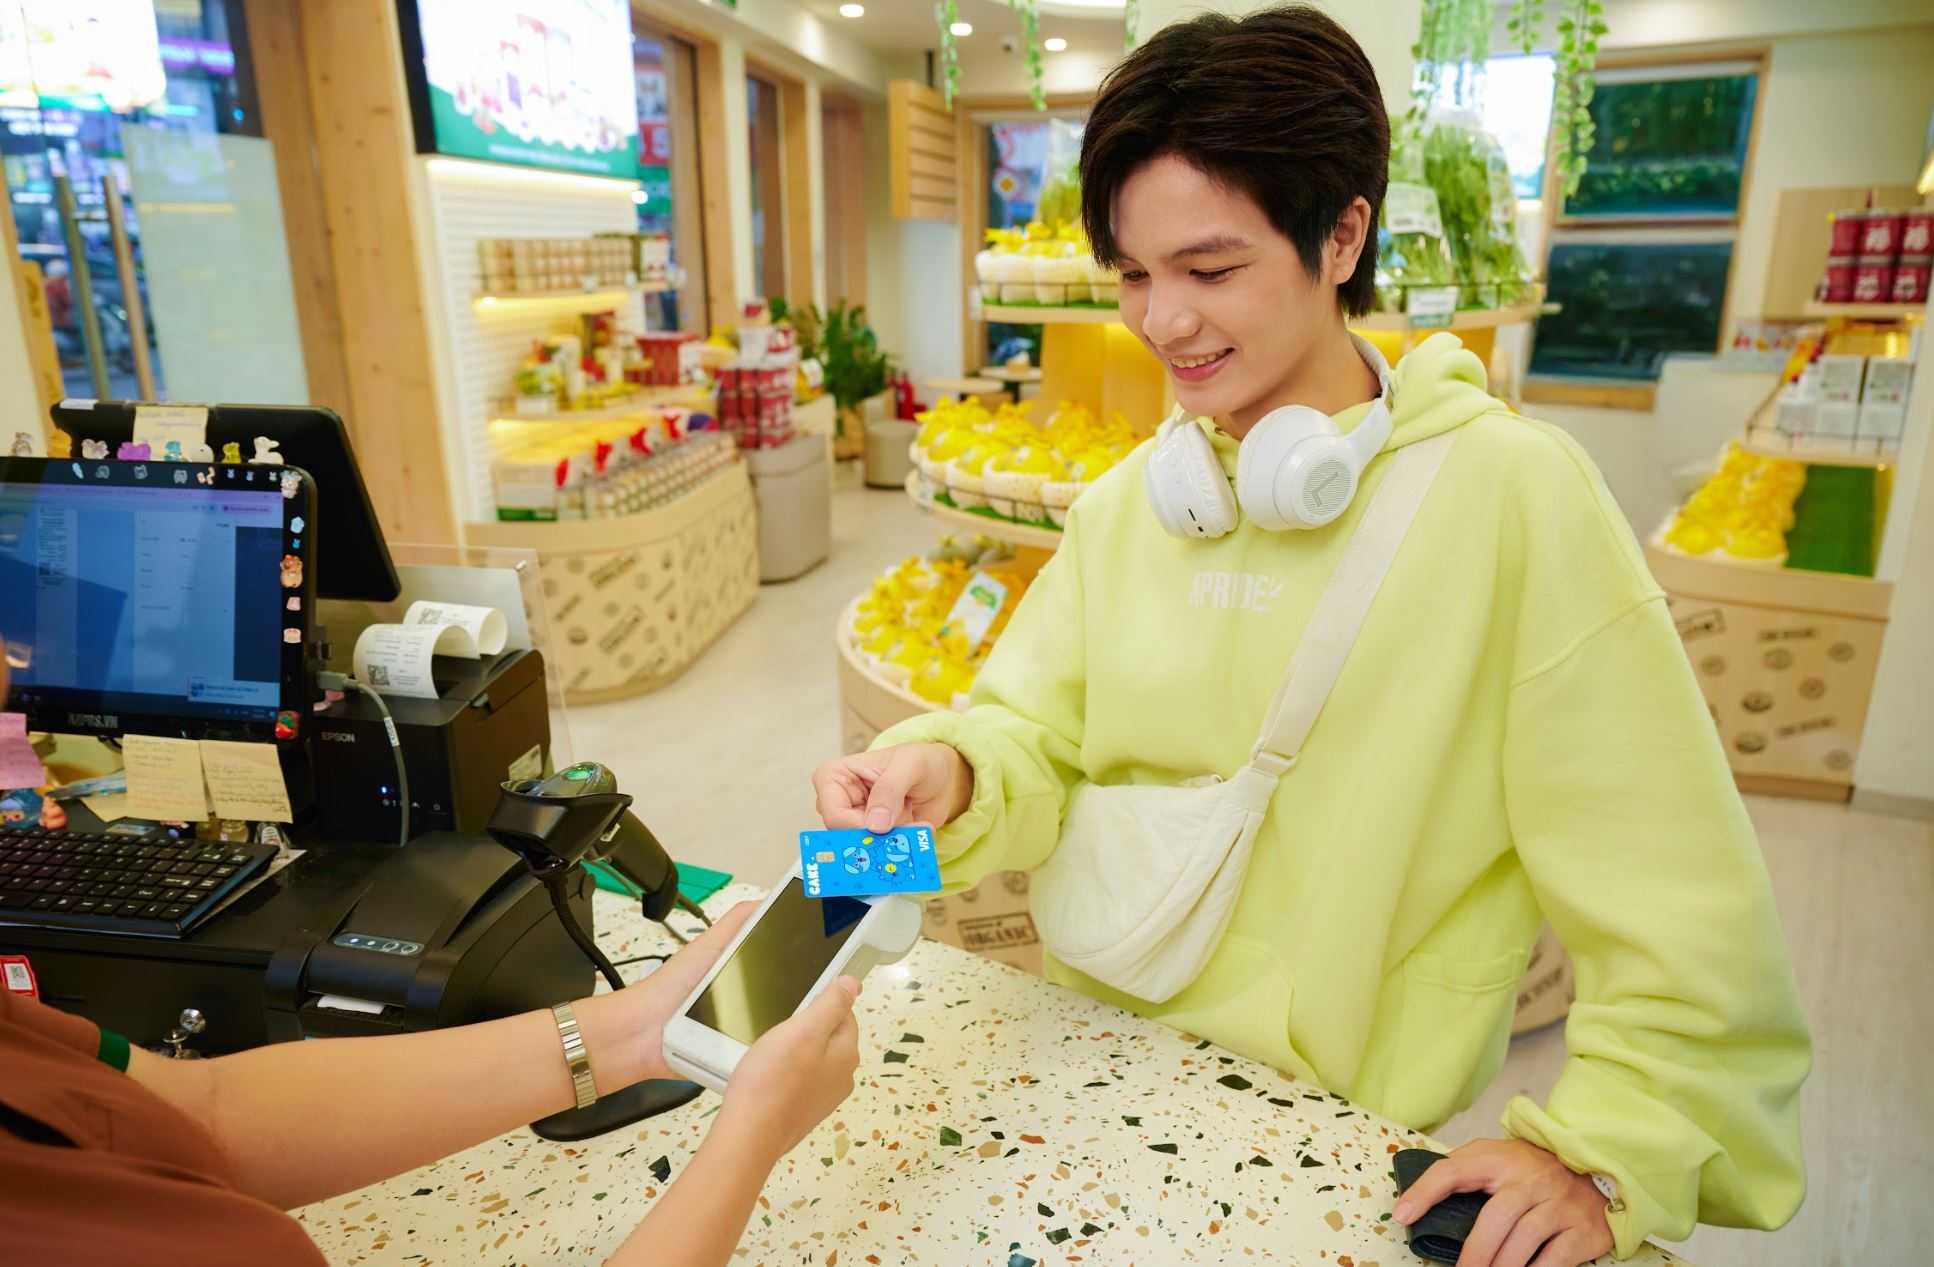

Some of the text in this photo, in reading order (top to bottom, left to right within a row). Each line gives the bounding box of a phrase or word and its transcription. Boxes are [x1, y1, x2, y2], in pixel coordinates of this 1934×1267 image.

[321, 732, 356, 743] EPSON
[917, 830, 931, 853] VISA
[806, 863, 821, 896] CAKE
